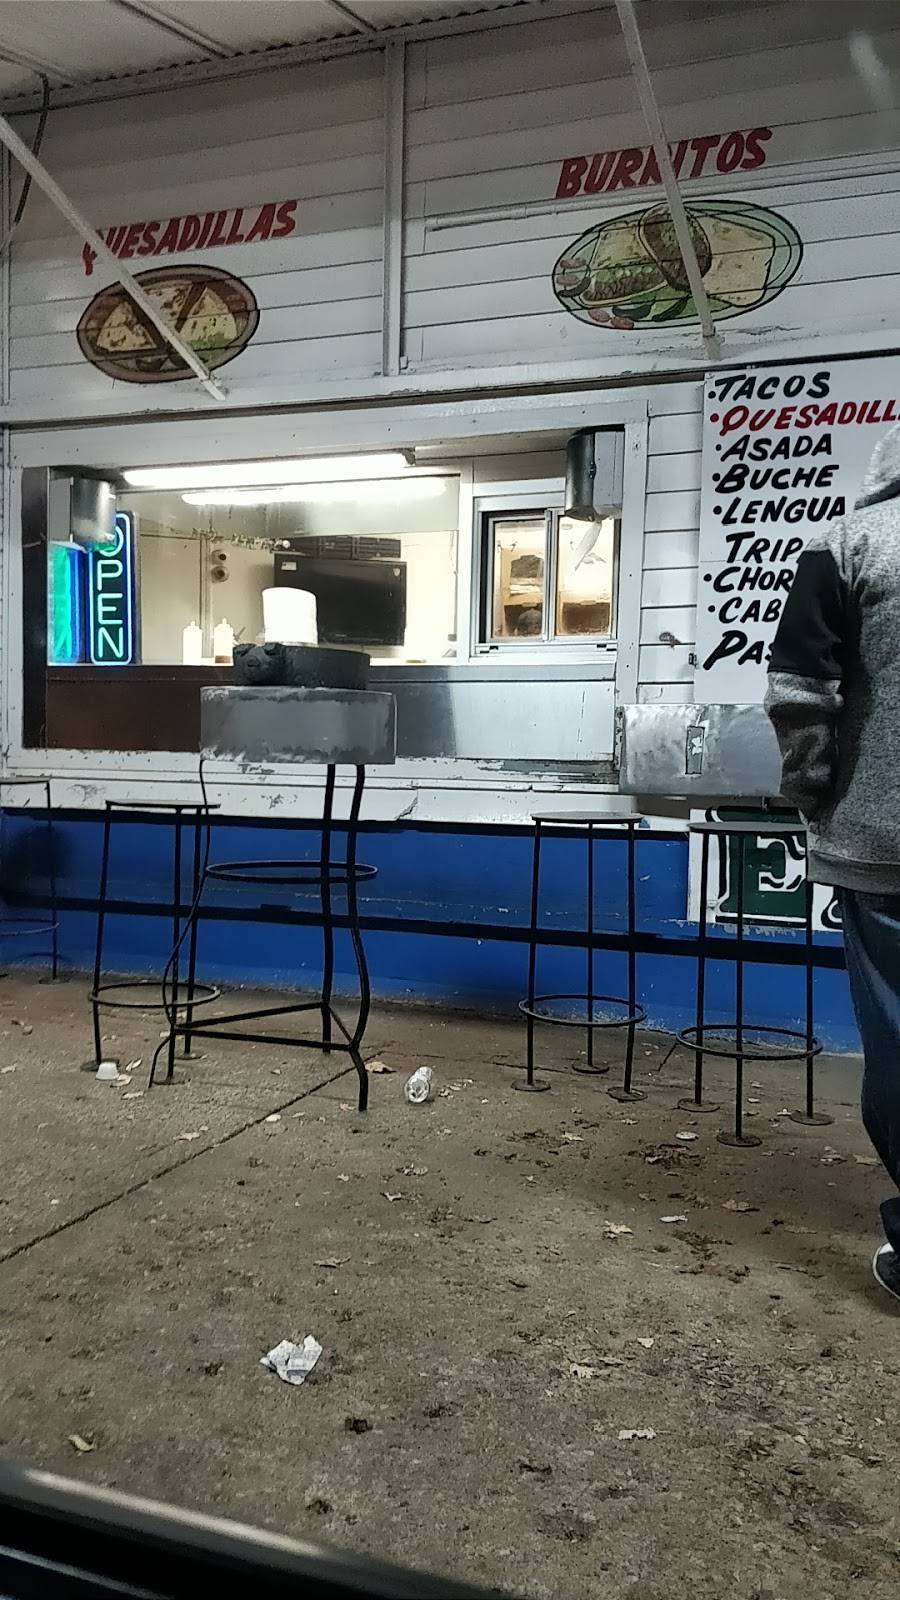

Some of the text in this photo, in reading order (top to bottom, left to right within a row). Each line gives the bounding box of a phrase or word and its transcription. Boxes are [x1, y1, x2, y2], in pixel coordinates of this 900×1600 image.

[555, 126, 773, 198] BURRITOS
[714, 371, 831, 402] TACOS
[719, 399, 900, 436] QUESADILL
[720, 433, 832, 462] ASADA
[714, 464, 840, 494] BUCHE
[721, 495, 846, 525] LENGUA
[725, 531, 804, 564] TRIP
[702, 630, 773, 671] PA
